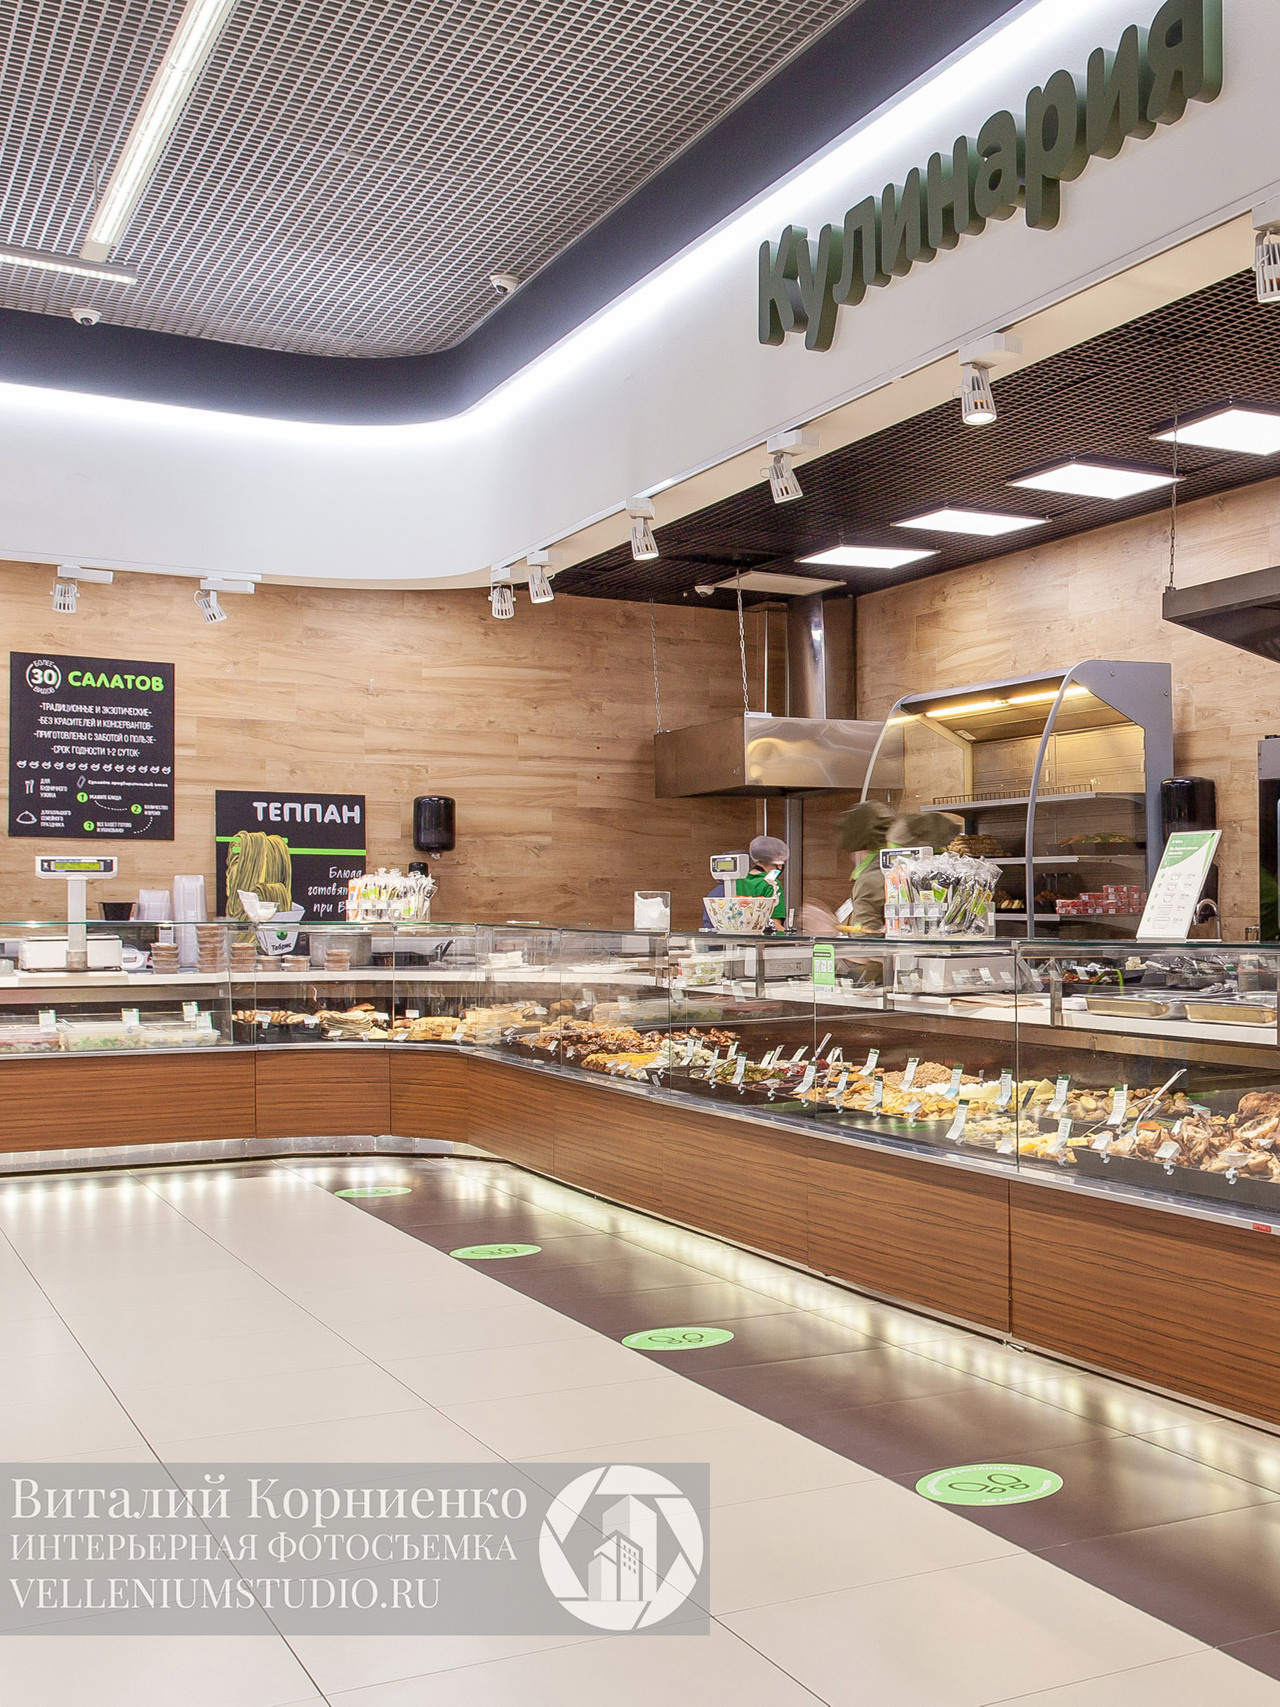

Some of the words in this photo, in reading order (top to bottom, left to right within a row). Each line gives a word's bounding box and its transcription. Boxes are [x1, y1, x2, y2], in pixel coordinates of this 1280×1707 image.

[758, 0, 1224, 353] Кулинария
[33, 659, 54, 667] БОЛЕЕ
[31, 668, 58, 685] 30
[68, 670, 164, 692] САЛАТОВ
[95, 706, 100, 714] И
[54, 717, 95, 728] КРАСИТЕЛЕЙ
[97, 720, 102, 728] И
[88, 732, 93, 740] С
[94, 732, 123, 742] ЗАБОТОЙ
[124, 734, 129, 743] О
[72, 746, 106, 755] ГОДНОСТИ
[107, 747, 117, 755] 1-2
[252, 801, 361, 824] ТЕППАН
[313, 903, 333, 918] при
